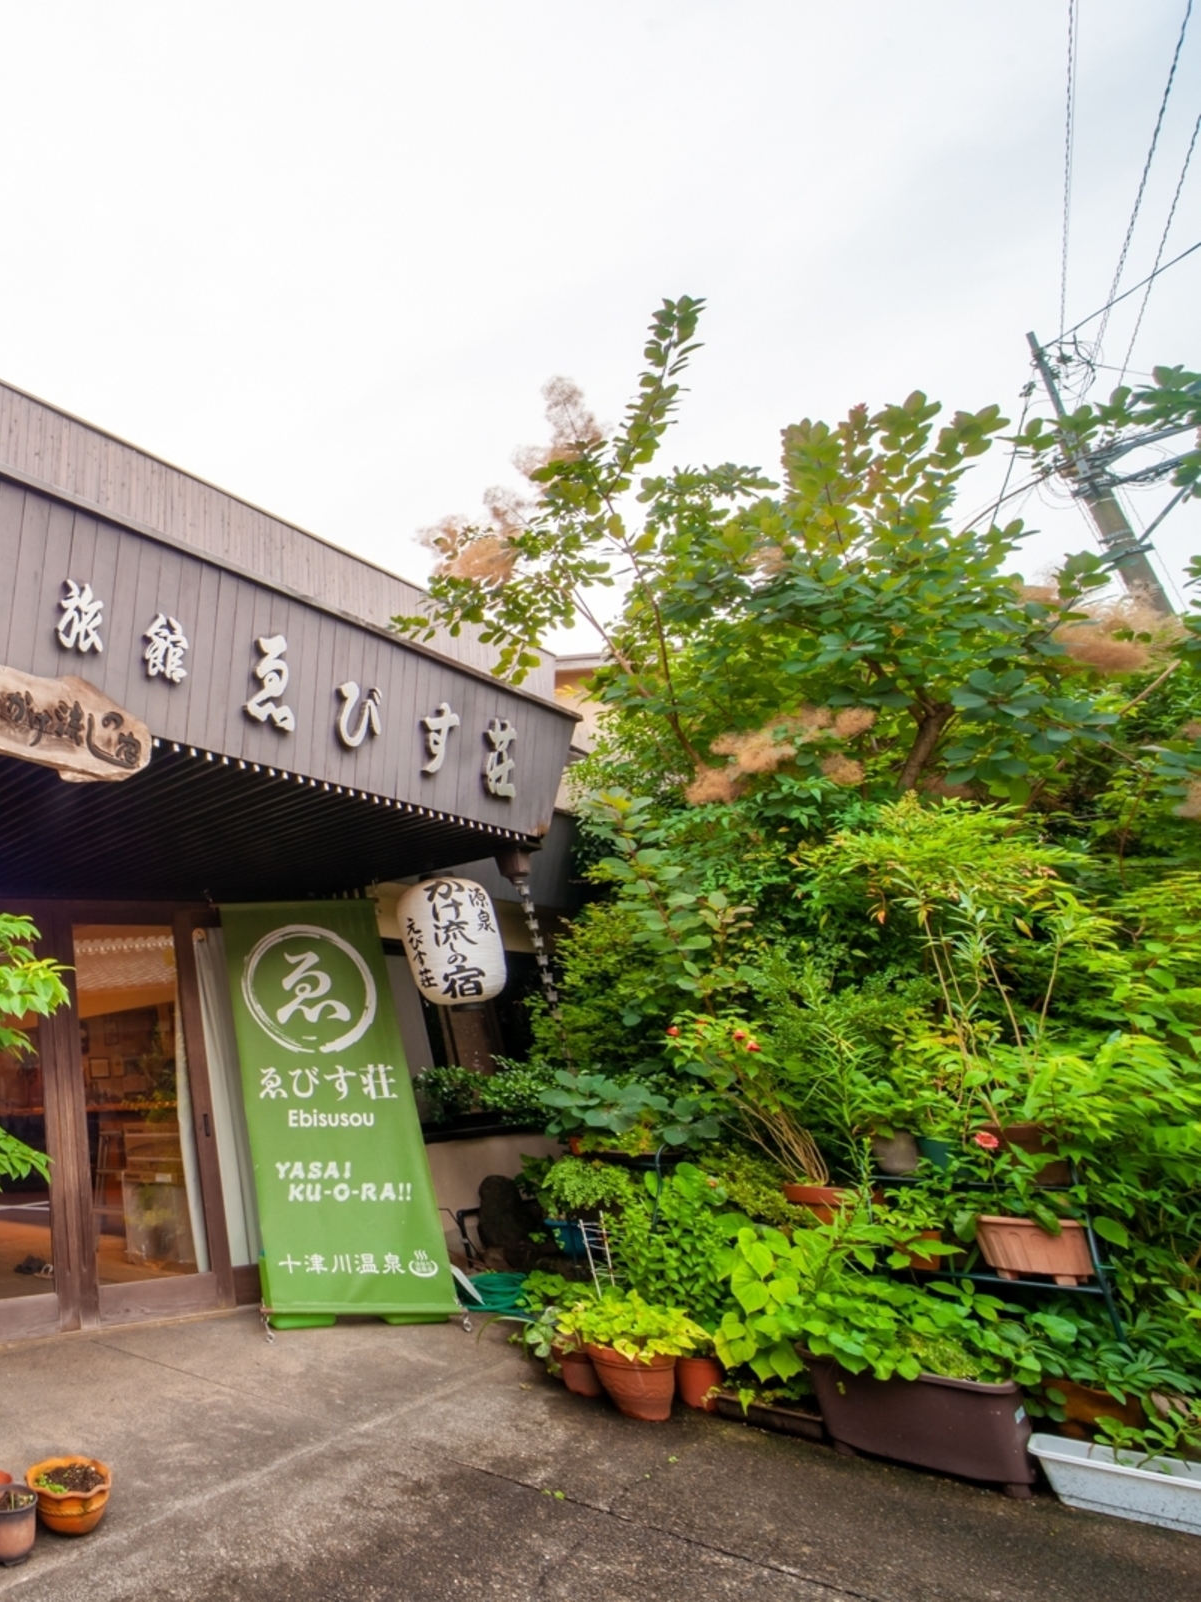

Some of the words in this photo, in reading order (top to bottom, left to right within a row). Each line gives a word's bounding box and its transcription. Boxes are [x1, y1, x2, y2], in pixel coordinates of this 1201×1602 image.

[468, 887, 496, 933] 源泉
[406, 917, 438, 988] えびす荘
[423, 880, 486, 999] かけ流しの宿
[259, 1063, 398, 1101] ゑびす荘
[288, 1108, 375, 1128] Ebisusou
[288, 1182, 412, 1202] KU-O-RA!!
[278, 1252, 406, 1275] 十津川温泉
